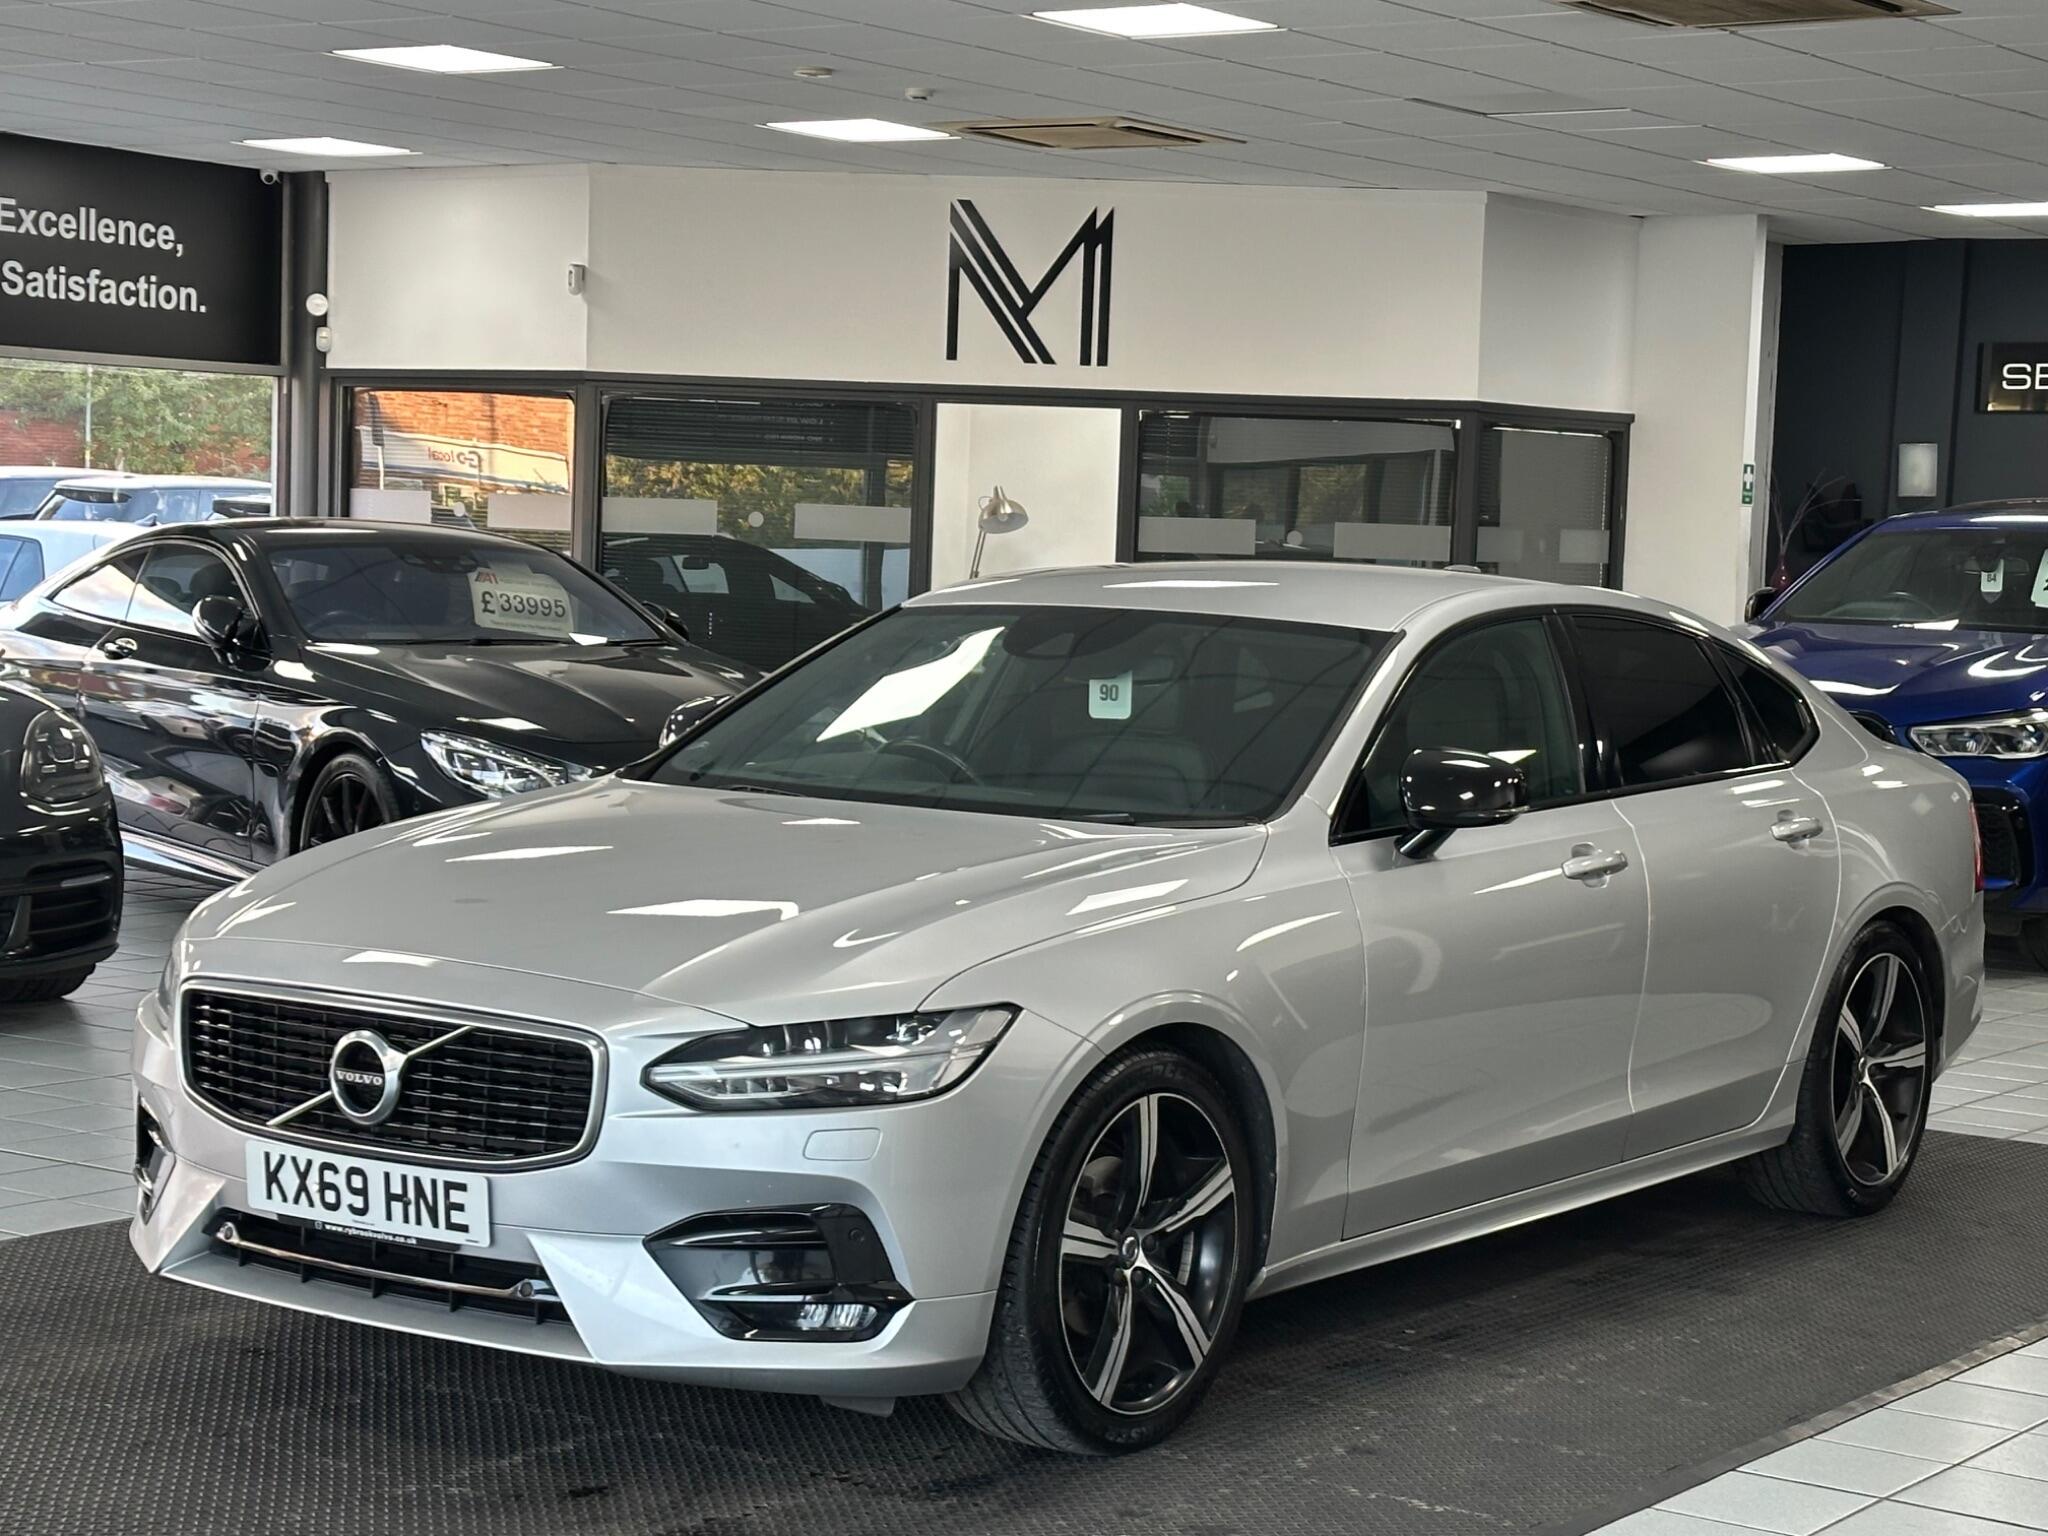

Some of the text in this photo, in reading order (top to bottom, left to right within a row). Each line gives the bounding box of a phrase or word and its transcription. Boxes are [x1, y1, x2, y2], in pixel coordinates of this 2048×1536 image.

[0, 197, 183, 257] Excellence,
[2, 260, 207, 313] Satisfaction.
[1099, 683, 1119, 701] 90
[335, 1070, 383, 1086] VOLVO
[263, 1151, 470, 1234] KX69 HNE
